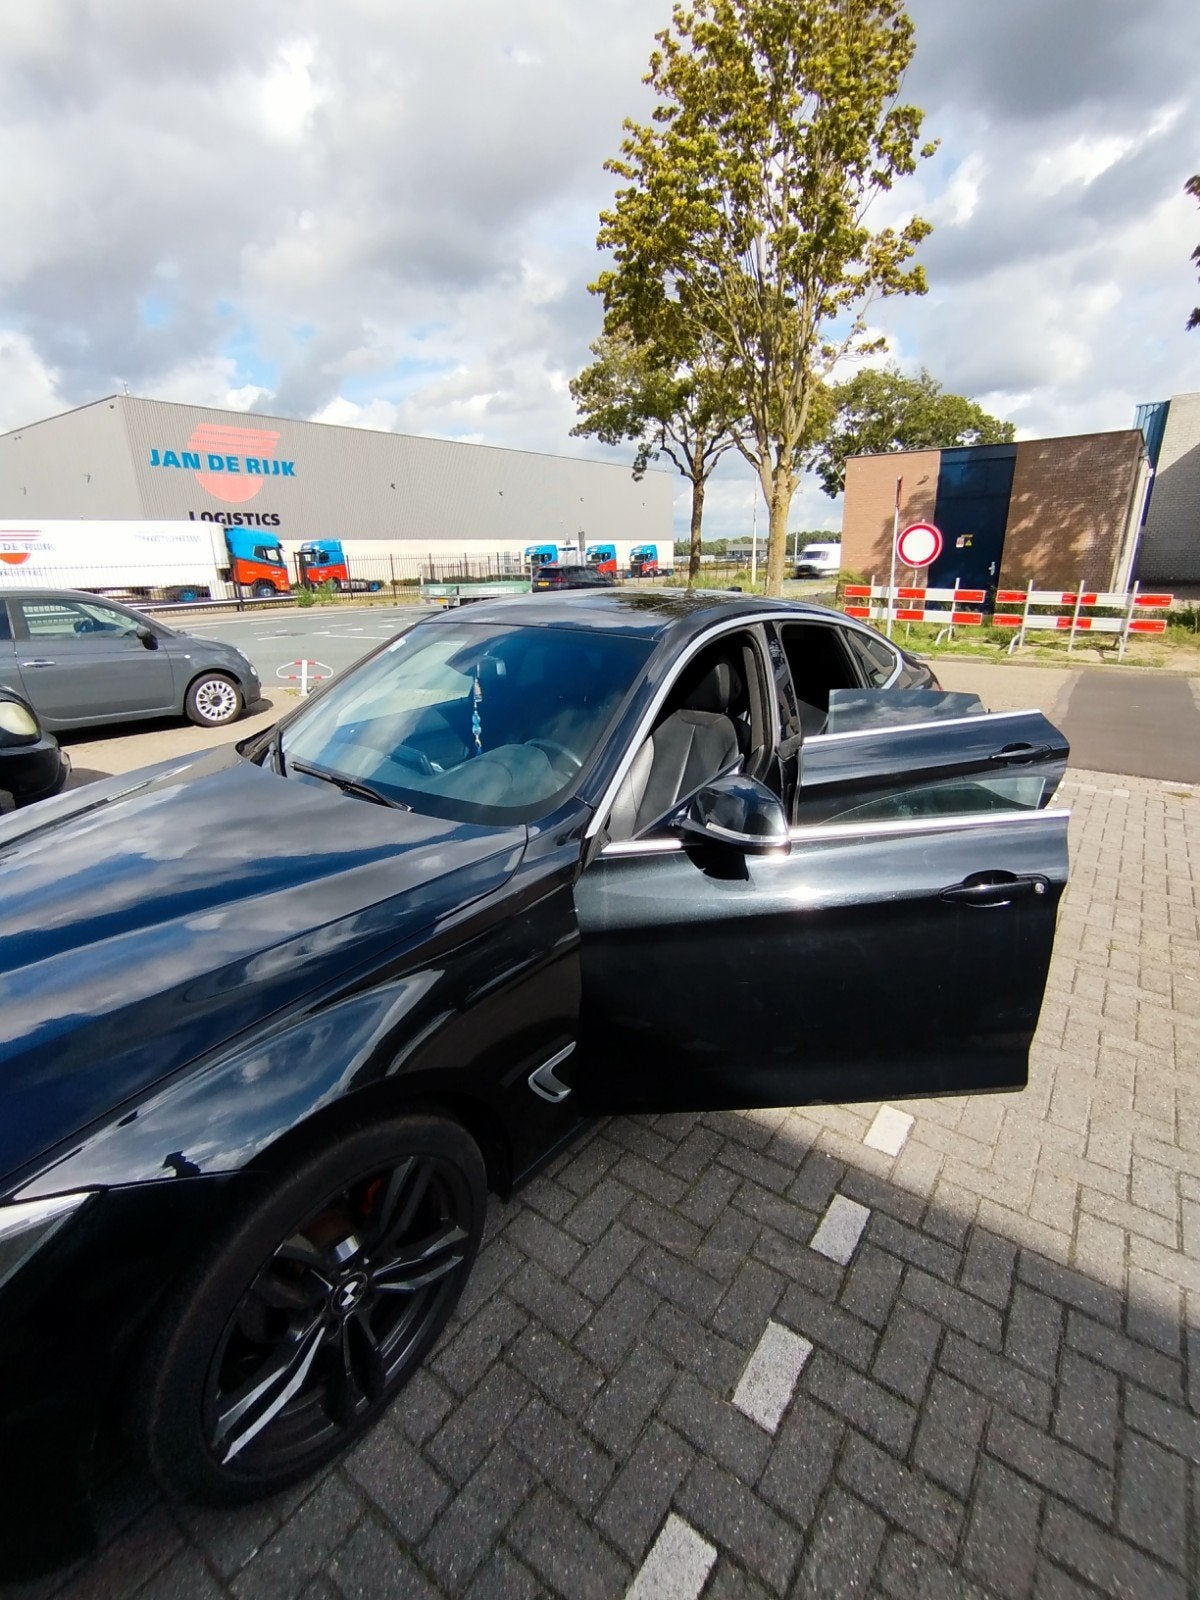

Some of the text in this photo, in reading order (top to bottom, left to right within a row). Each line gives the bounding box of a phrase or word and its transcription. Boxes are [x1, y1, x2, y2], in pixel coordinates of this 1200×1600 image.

[150, 448, 297, 476] JAN DE RIJK
[189, 511, 281, 526] LOGISTICS
